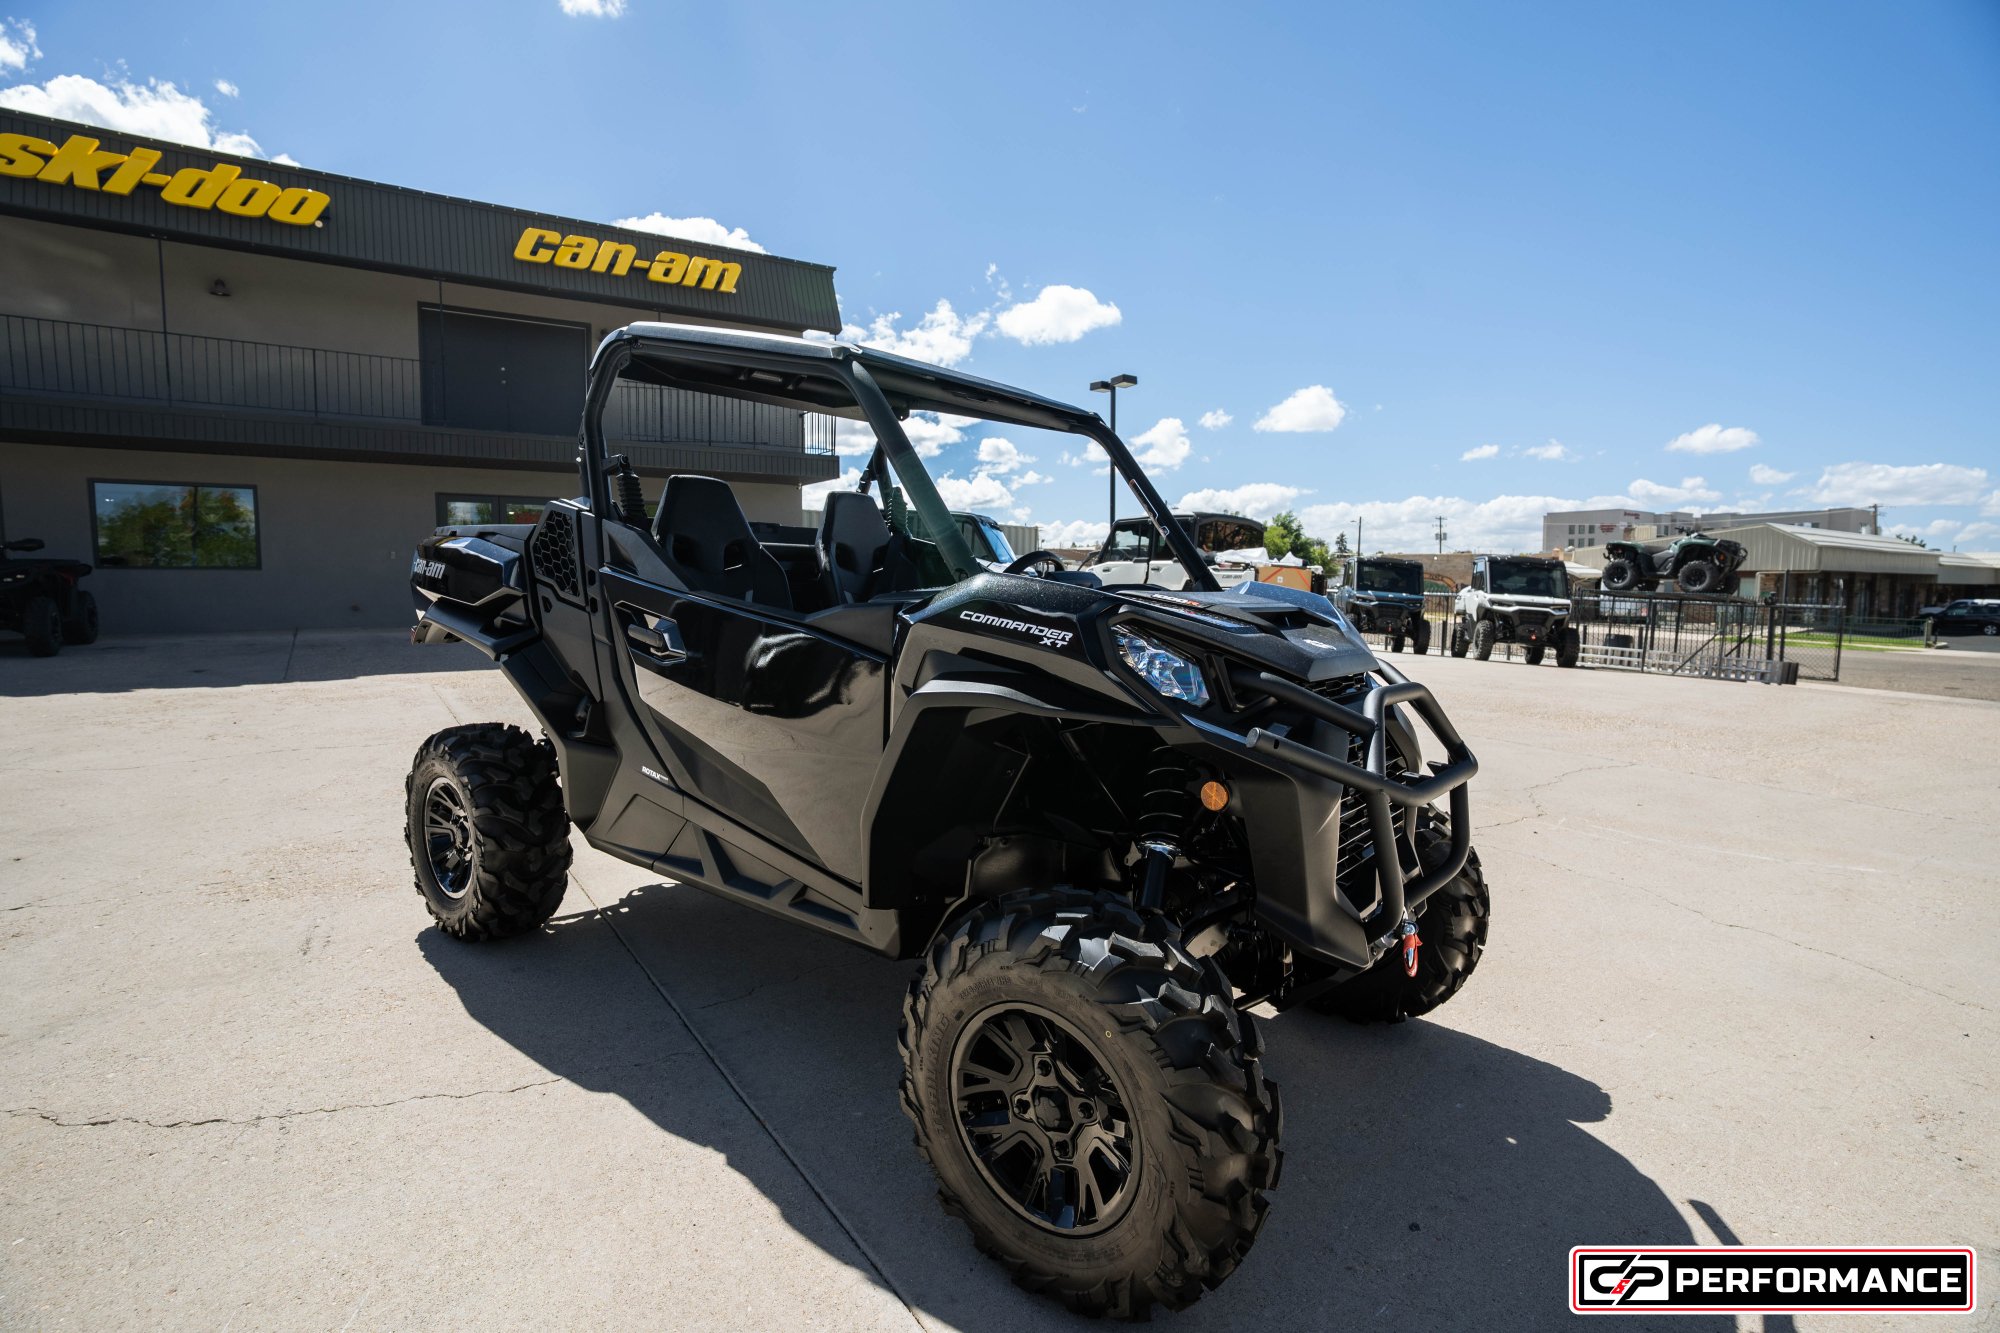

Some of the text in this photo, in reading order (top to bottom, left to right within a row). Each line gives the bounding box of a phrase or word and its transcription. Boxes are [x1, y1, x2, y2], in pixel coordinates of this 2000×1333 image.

[0, 132, 331, 226] ski-doo
[513, 227, 742, 294] can-am
[959, 610, 1073, 642] COMMANDER
[1038, 636, 1068, 648] XT
[641, 765, 661, 781] ROTAX
